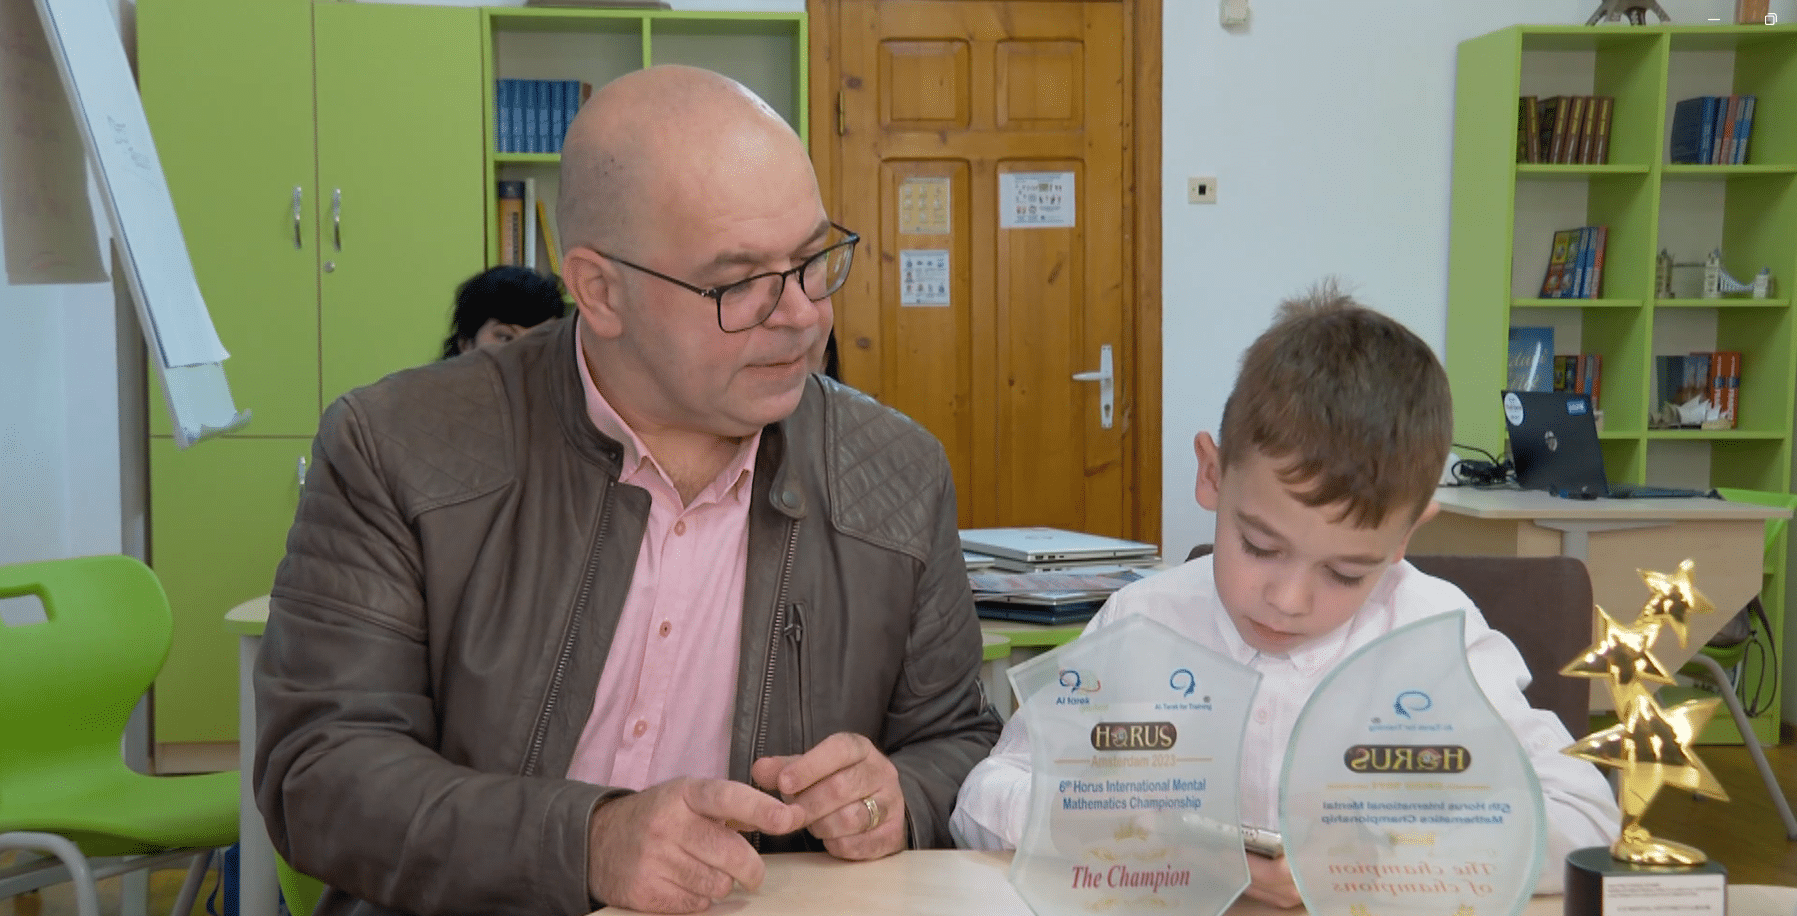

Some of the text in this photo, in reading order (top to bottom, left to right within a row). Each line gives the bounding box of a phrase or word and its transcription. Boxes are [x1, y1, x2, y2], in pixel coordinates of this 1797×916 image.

[1095, 724, 1173, 748] HORUS
[1090, 754, 1176, 767] Amsterdam 2023
[1073, 780, 1103, 793] Horus
[1106, 779, 1170, 792] International
[1172, 778, 1207, 791] Mental
[1063, 797, 1202, 811] Mathematics Championship
[1072, 864, 1191, 893] The Champion
